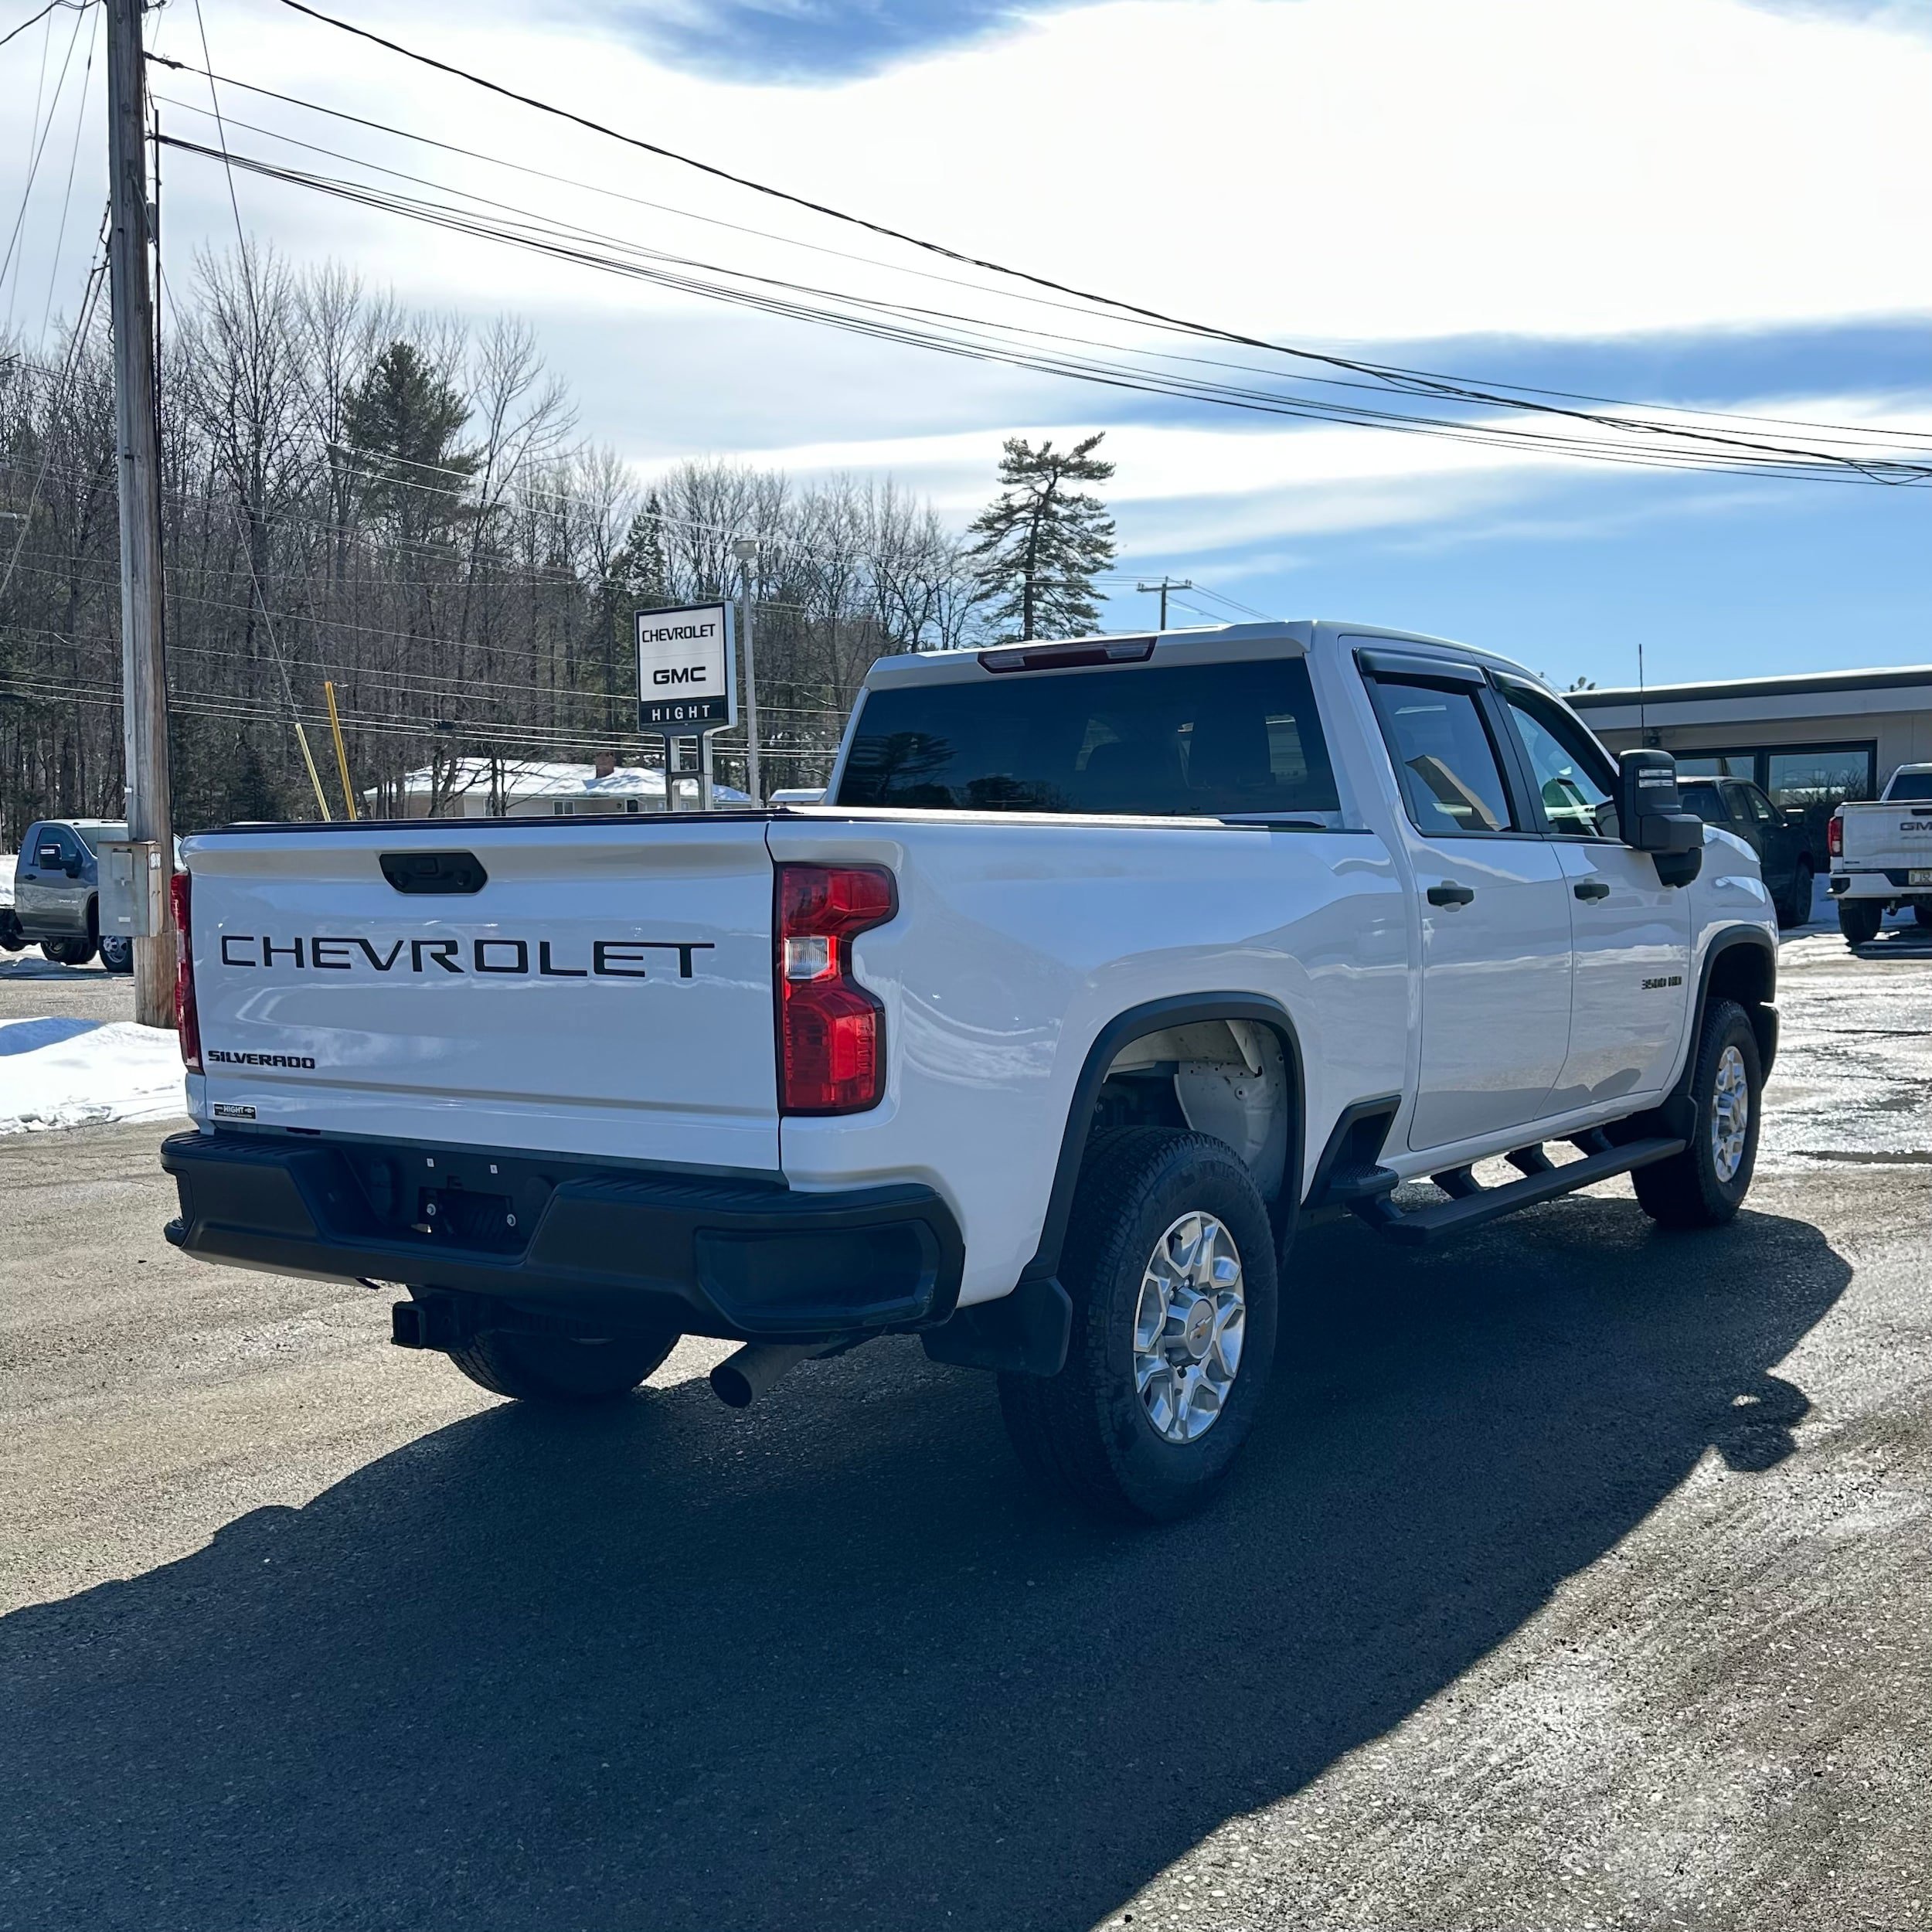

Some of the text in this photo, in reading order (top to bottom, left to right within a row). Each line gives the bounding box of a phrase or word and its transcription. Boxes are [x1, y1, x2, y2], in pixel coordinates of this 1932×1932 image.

[642, 624, 716, 643] CHEVROLET
[653, 666, 706, 685] GMC
[651, 705, 710, 721] HIGHT
[221, 935, 715, 978] CHEVROLET
[208, 1050, 315, 1069] SILVERADO
[223, 1105, 244, 1114] HIGHT
